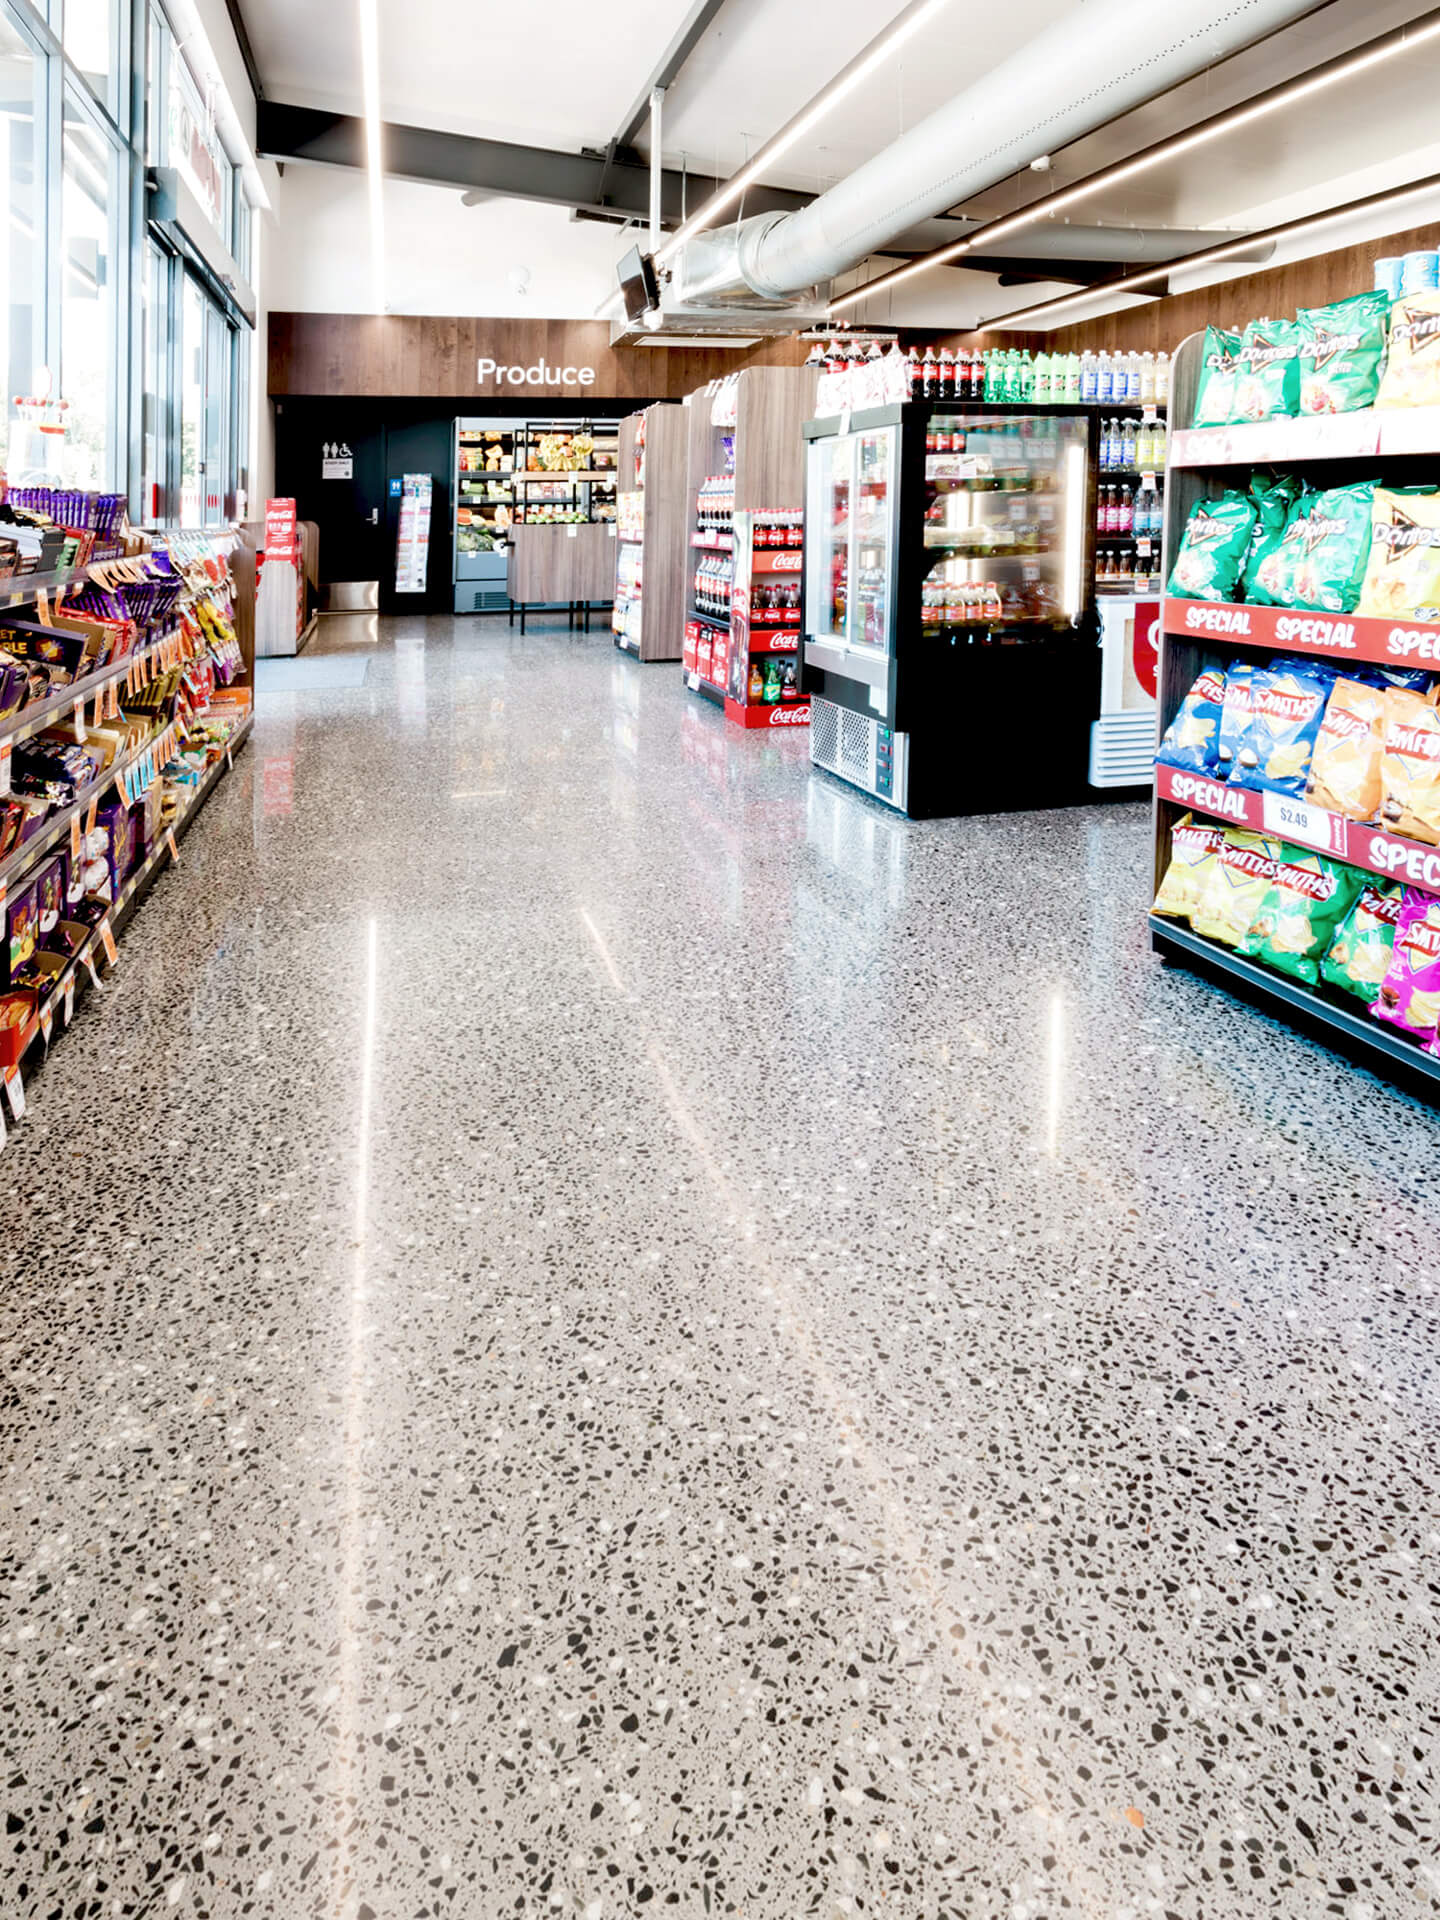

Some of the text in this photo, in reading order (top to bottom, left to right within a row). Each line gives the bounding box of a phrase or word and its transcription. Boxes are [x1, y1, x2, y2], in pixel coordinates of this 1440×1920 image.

[476, 358, 596, 386] Produce
[1185, 607, 1252, 635] SPECIAL
[1275, 616, 1357, 649] SPECIAL
[1170, 772, 1249, 820] SPECIAL
[1280, 807, 1308, 828] $2.49
